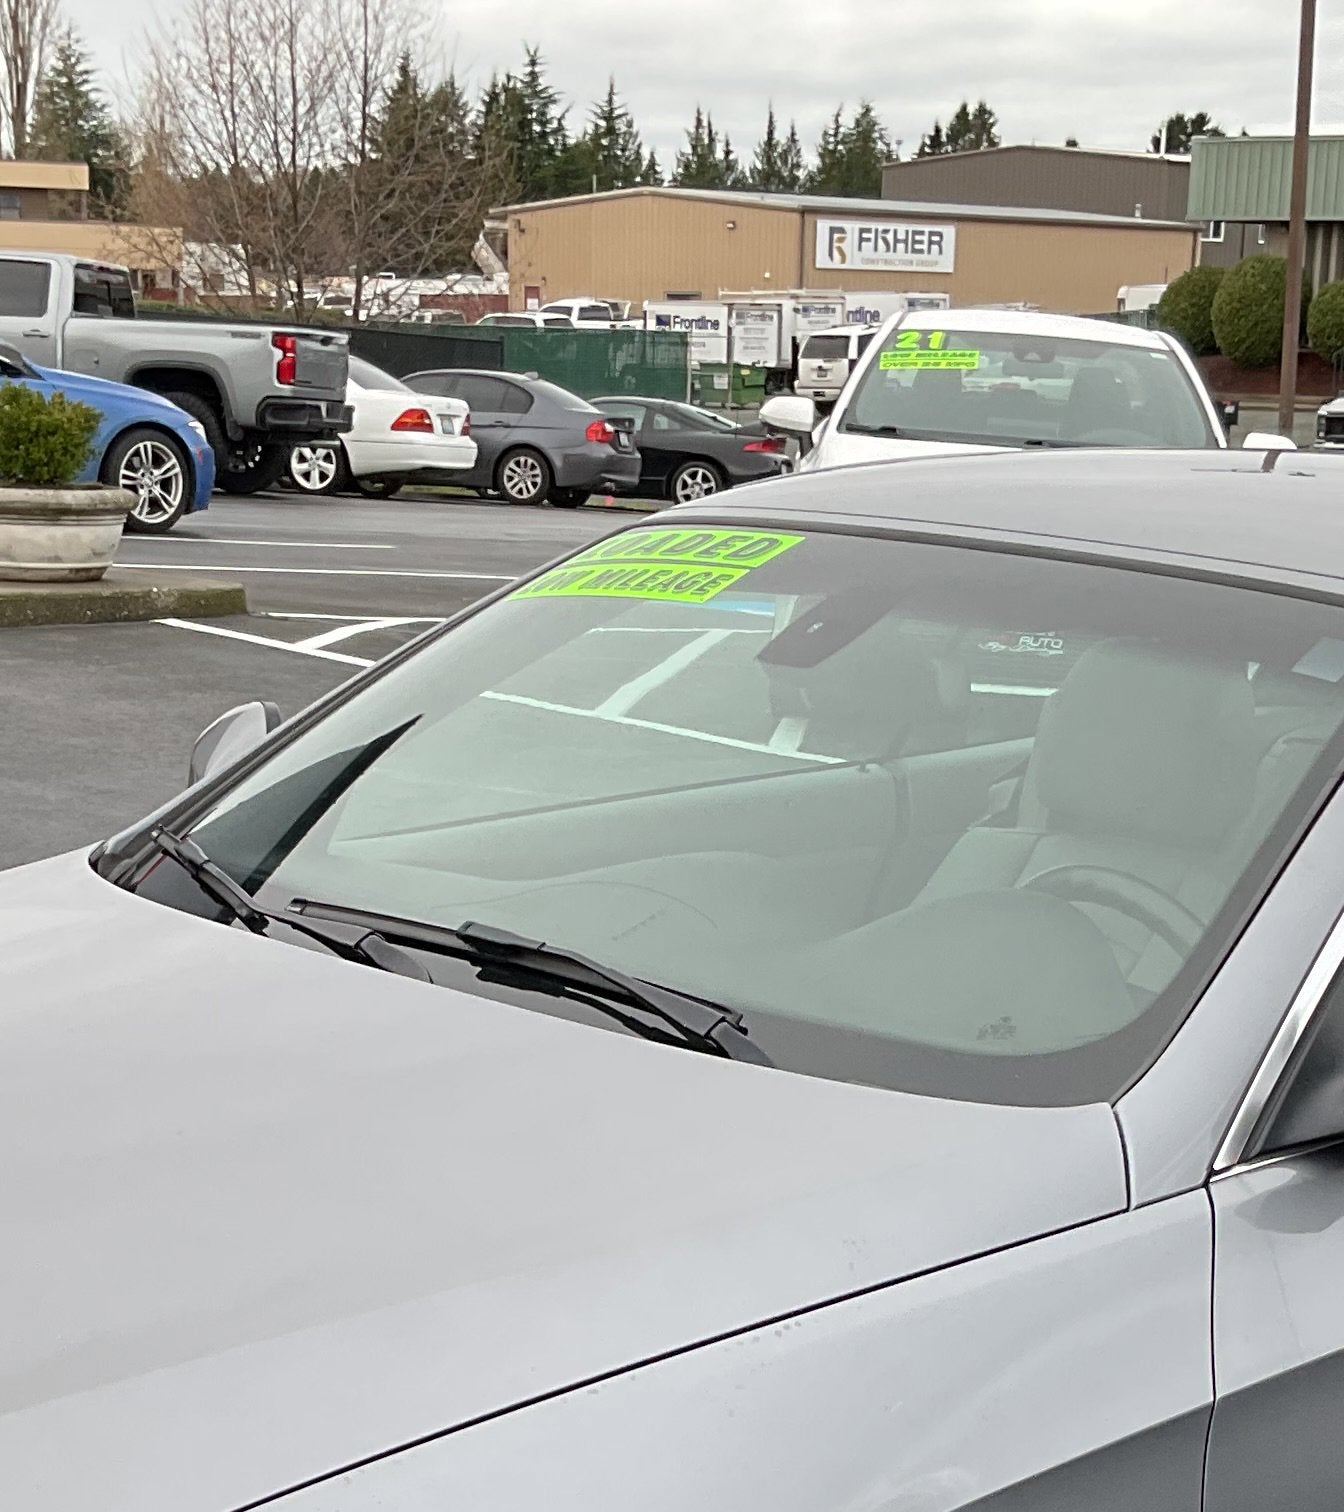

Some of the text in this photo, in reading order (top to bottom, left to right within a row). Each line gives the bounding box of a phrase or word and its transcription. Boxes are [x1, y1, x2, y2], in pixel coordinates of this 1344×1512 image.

[857, 227, 944, 256] FISHER
[672, 315, 720, 330] Frontline
[895, 331, 944, 350] 21
[577, 568, 736, 596] MILEAGE
[1018, 636, 1063, 649] AUTO
